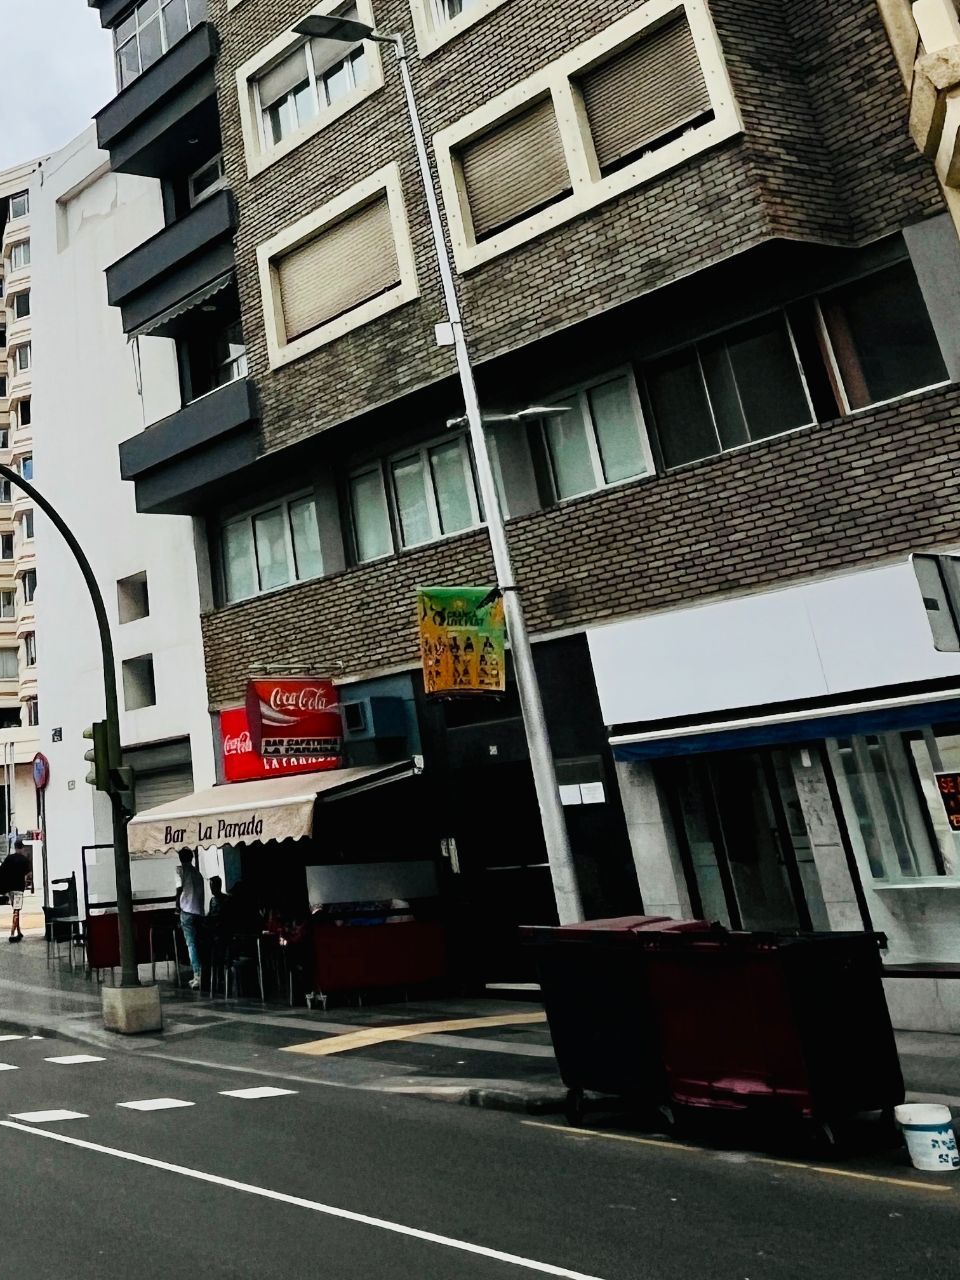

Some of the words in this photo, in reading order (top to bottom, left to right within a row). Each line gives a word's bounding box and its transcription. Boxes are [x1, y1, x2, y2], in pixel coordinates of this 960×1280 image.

[164, 825, 187, 844] Bar
[198, 822, 213, 841] La
[217, 815, 263, 839] Parada
